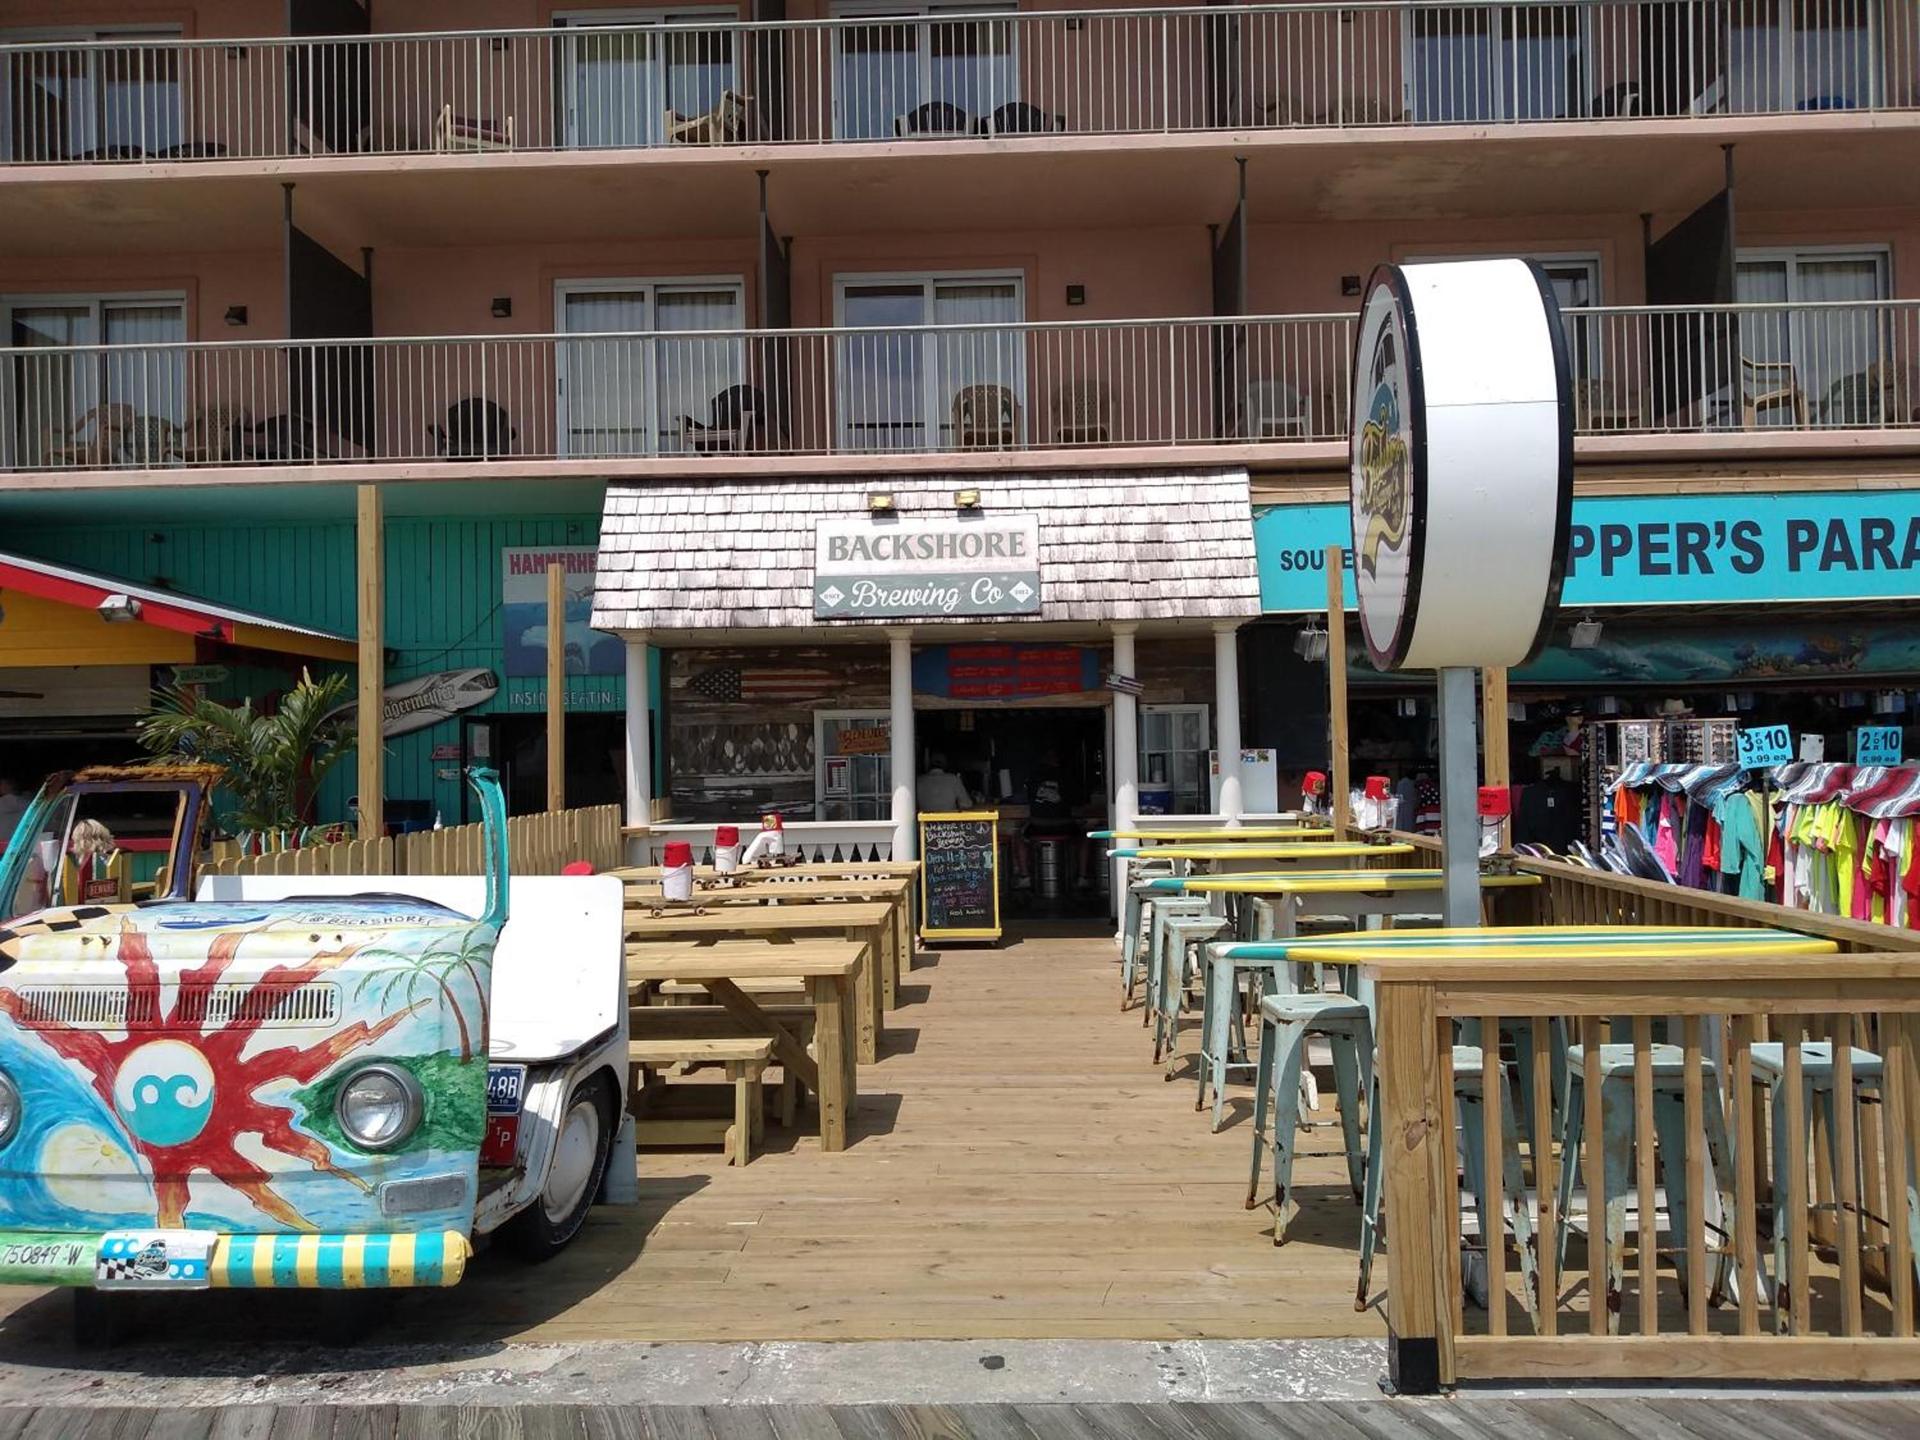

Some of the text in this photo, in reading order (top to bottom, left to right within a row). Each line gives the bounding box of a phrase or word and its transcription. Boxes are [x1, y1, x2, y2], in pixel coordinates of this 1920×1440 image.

[828, 531, 1026, 561] BACKSHORE
[1564, 519, 1765, 577] PPER'S
[1280, 549, 1354, 571] SOUE
[851, 577, 1004, 613] Brewing Co
[383, 685, 456, 719] ägermeister
[1741, 729, 1788, 752] 3 FOR 10
[1861, 731, 1871, 751] 2
[1882, 730, 1900, 750] 10
[1746, 754, 1770, 764] 3.99
